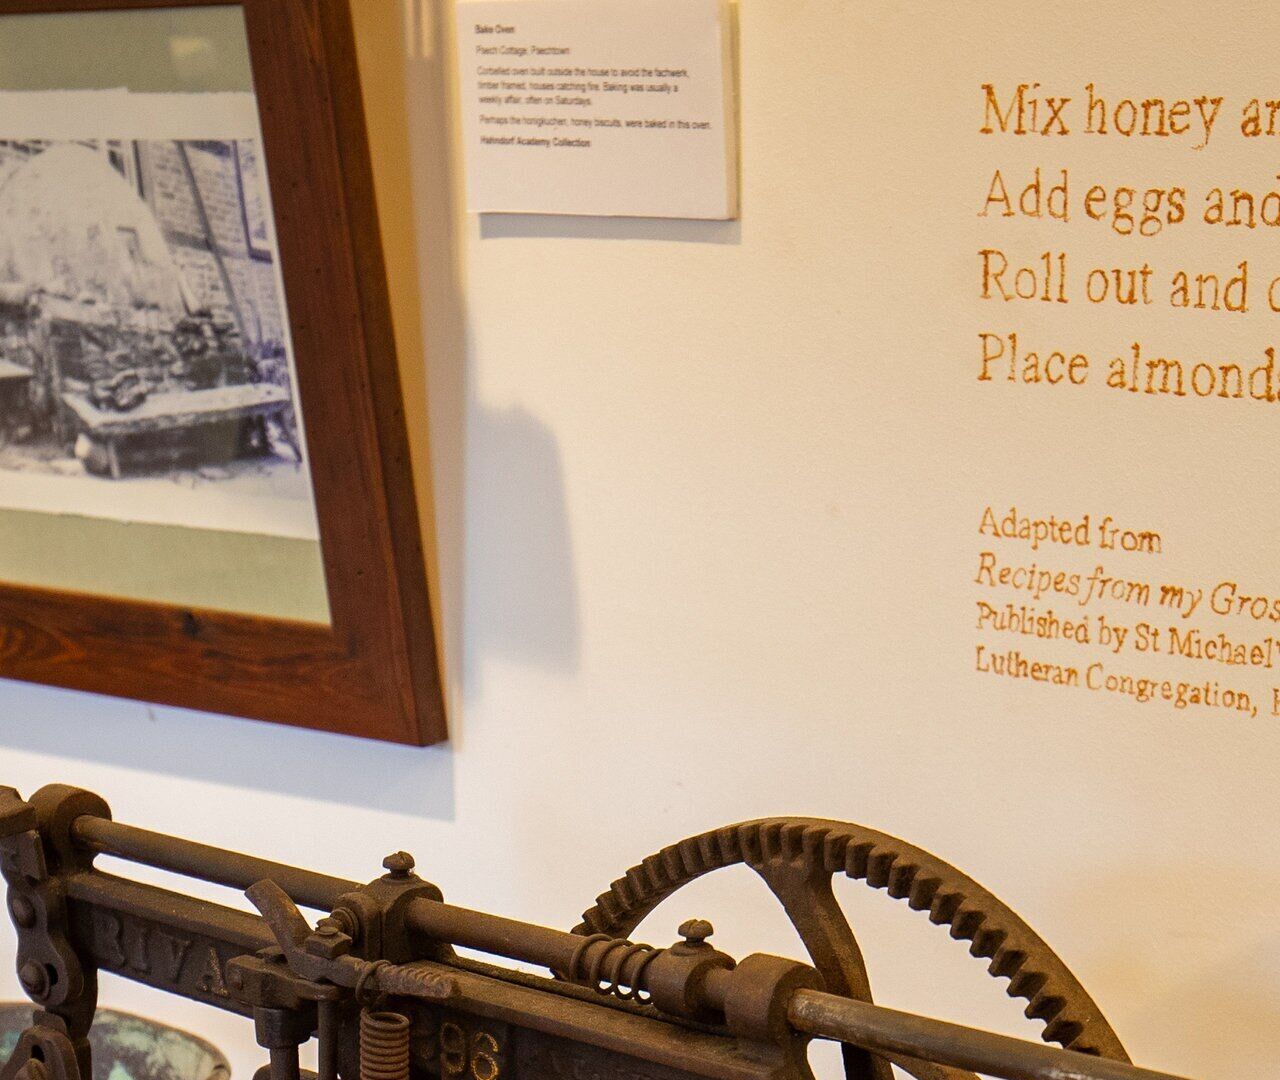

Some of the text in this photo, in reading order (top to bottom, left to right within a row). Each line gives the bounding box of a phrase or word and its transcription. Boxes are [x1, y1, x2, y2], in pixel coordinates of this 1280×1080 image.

[978, 82, 1073, 136] Mix
[1083, 82, 1225, 151] honey
[977, 166, 1071, 223] Add
[1083, 184, 1187, 237] eggs
[977, 248, 1069, 304] Roll
[1085, 263, 1154, 306] out
[1169, 260, 1250, 314] and
[976, 331, 1090, 386] Place
[978, 506, 1162, 554] Adapted from
[973, 549, 1081, 600] Recipes
[1078, 565, 1151, 607] from
[1158, 584, 1203, 619] my
[975, 600, 1091, 644] Published
[1097, 614, 1129, 654] by
[1134, 621, 1160, 652] St
[975, 644, 1080, 687] Lutheran
[1085, 661, 1259, 719] Congregation,
